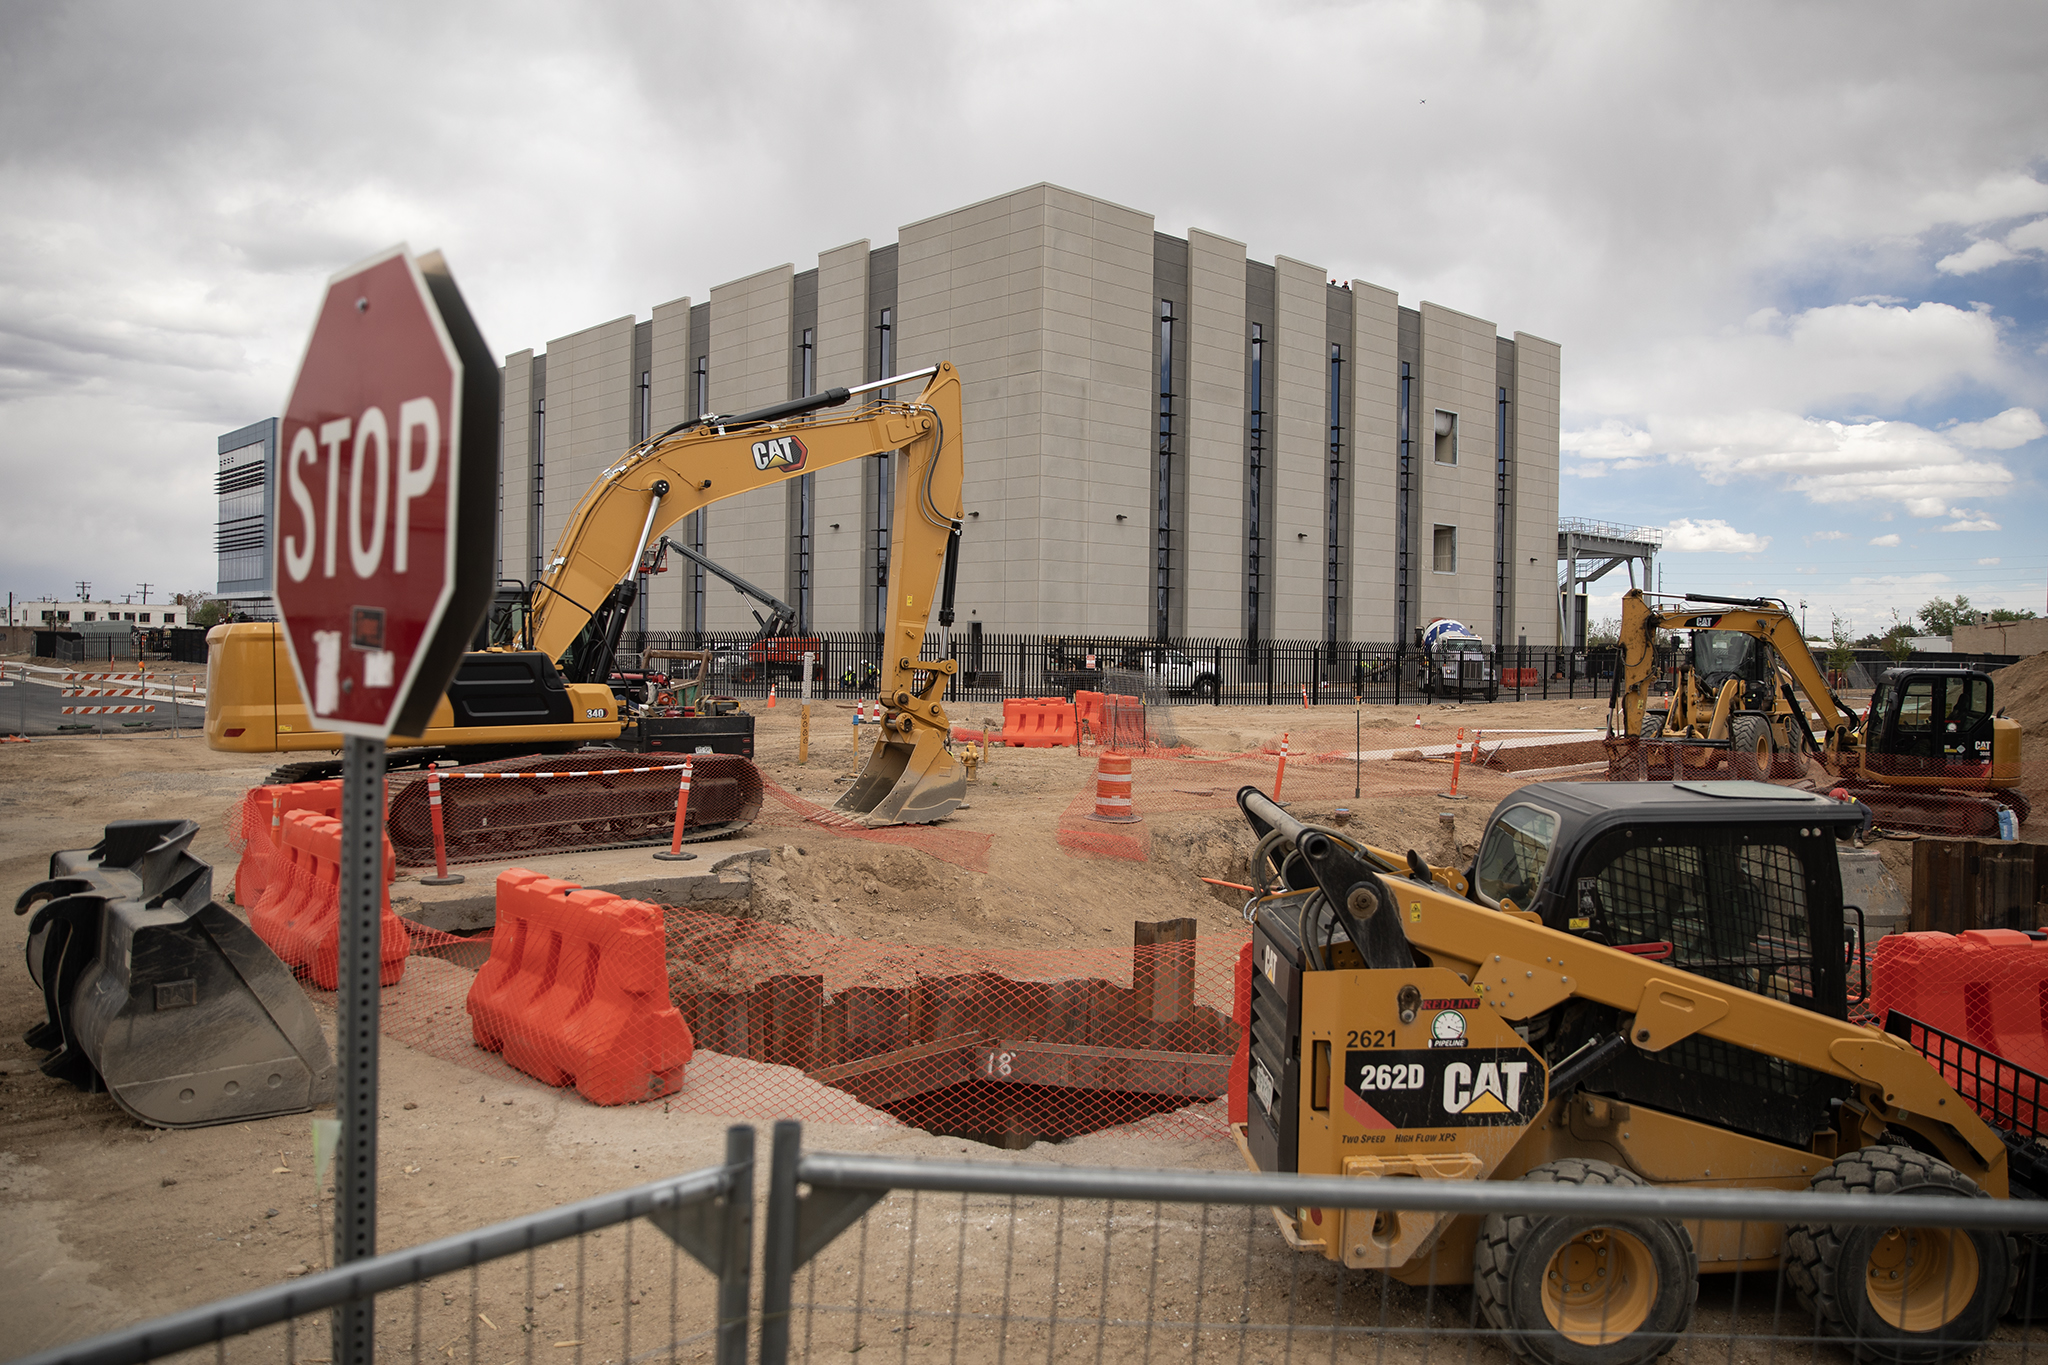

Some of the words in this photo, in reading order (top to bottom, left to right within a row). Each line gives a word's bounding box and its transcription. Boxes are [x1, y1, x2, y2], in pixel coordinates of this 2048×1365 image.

[752, 436, 794, 470] CAT
[284, 396, 441, 583] STOP
[1696, 617, 1712, 627] CAT
[586, 708, 604, 719] 340
[1974, 741, 1991, 751] CAT
[1264, 944, 1278, 985] CAT
[1421, 998, 1480, 1010] REDLINE
[1346, 1030, 1396, 1048] 2621
[1433, 1039, 1466, 1048] PIPELINE
[1360, 1063, 1425, 1091] 262D
[1442, 1061, 1528, 1114] CAT
[1438, 1132, 1457, 1142] XPS
